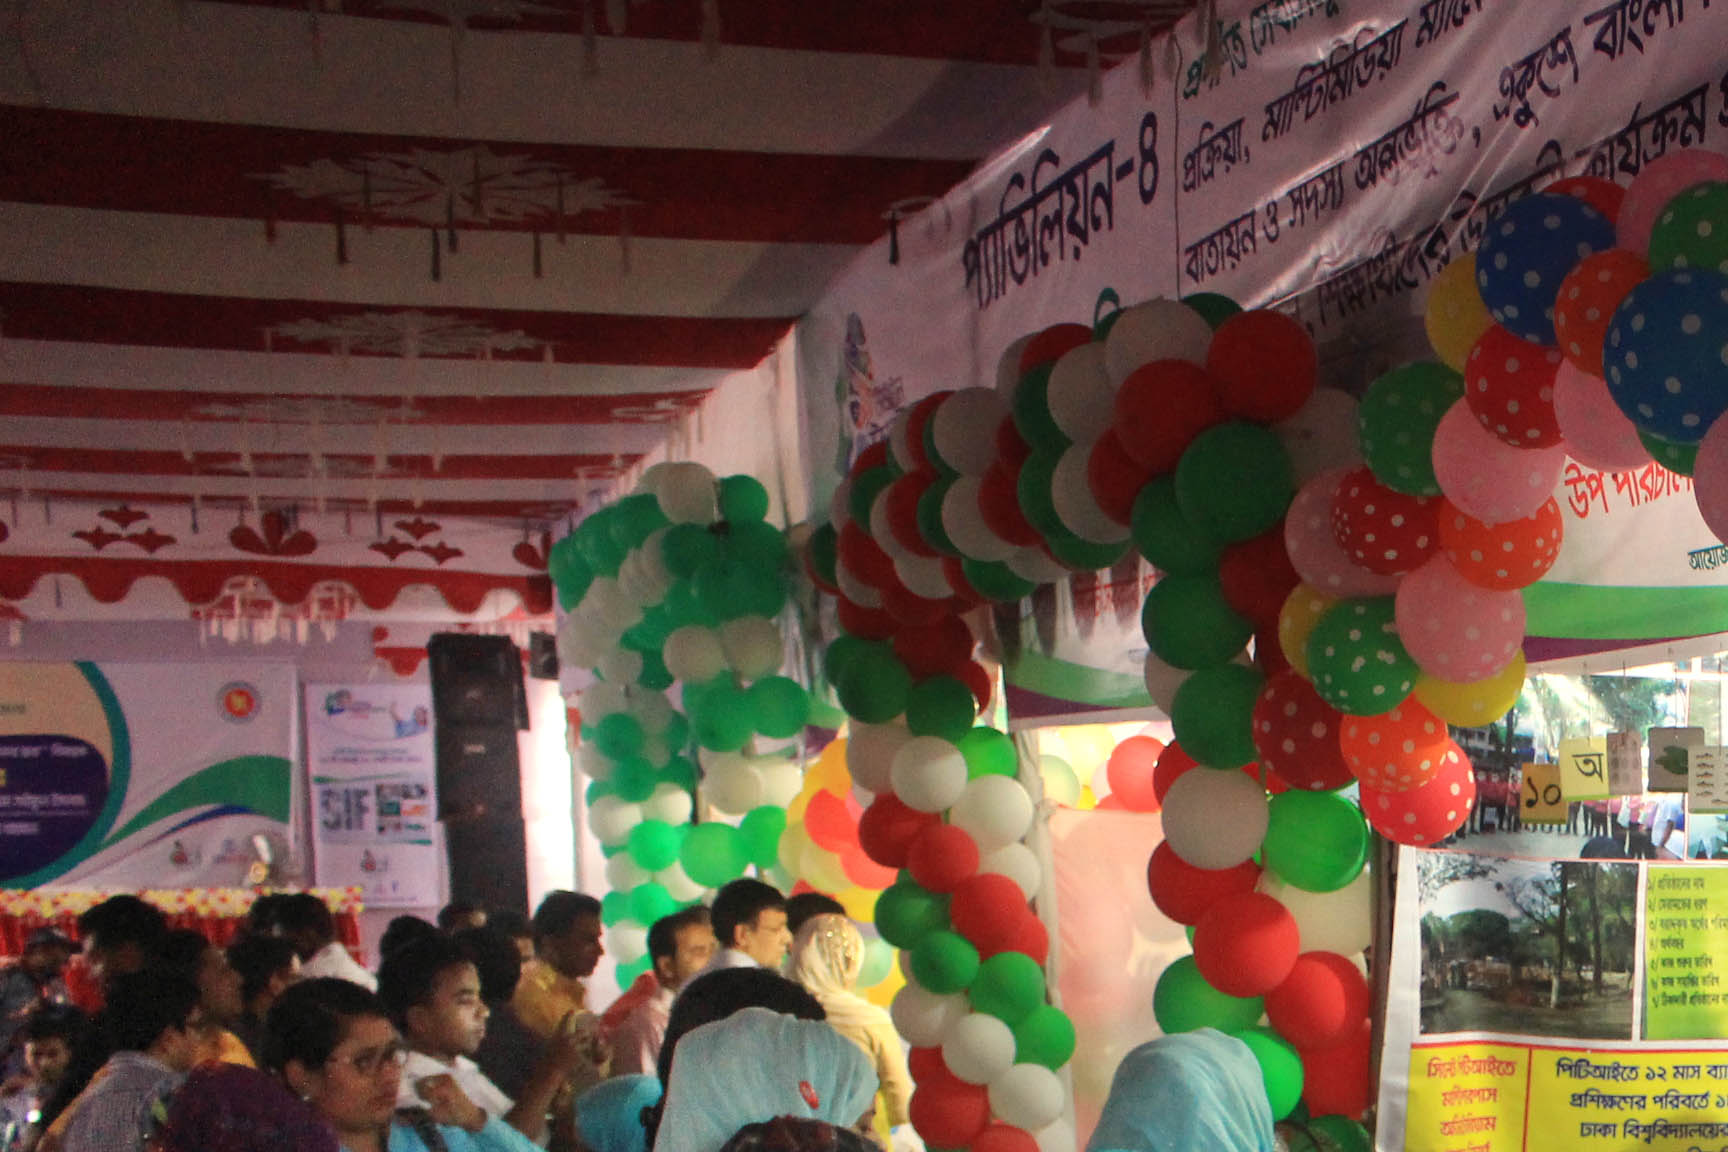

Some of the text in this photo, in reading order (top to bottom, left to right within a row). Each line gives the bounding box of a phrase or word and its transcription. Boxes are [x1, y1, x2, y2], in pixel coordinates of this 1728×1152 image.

[1262, 200, 1280, 244] ও
[1492, 26, 1580, 129] একুশে
[962, 111, 1160, 310] প্যাভিলিয়ন-৪
[1572, 752, 1605, 784] অ
[1525, 776, 1562, 809] ১০
[1556, 1057, 1639, 1082] পিটিআইতে
[1645, 1066, 1668, 1081] ১২
[1673, 1064, 1701, 1080] মাস
[1569, 1087, 1647, 1111] প্রশিক্ষণের
[1653, 1089, 1710, 1110] পরিবর্তে
[1580, 1121, 1617, 1138] ঢাকা
